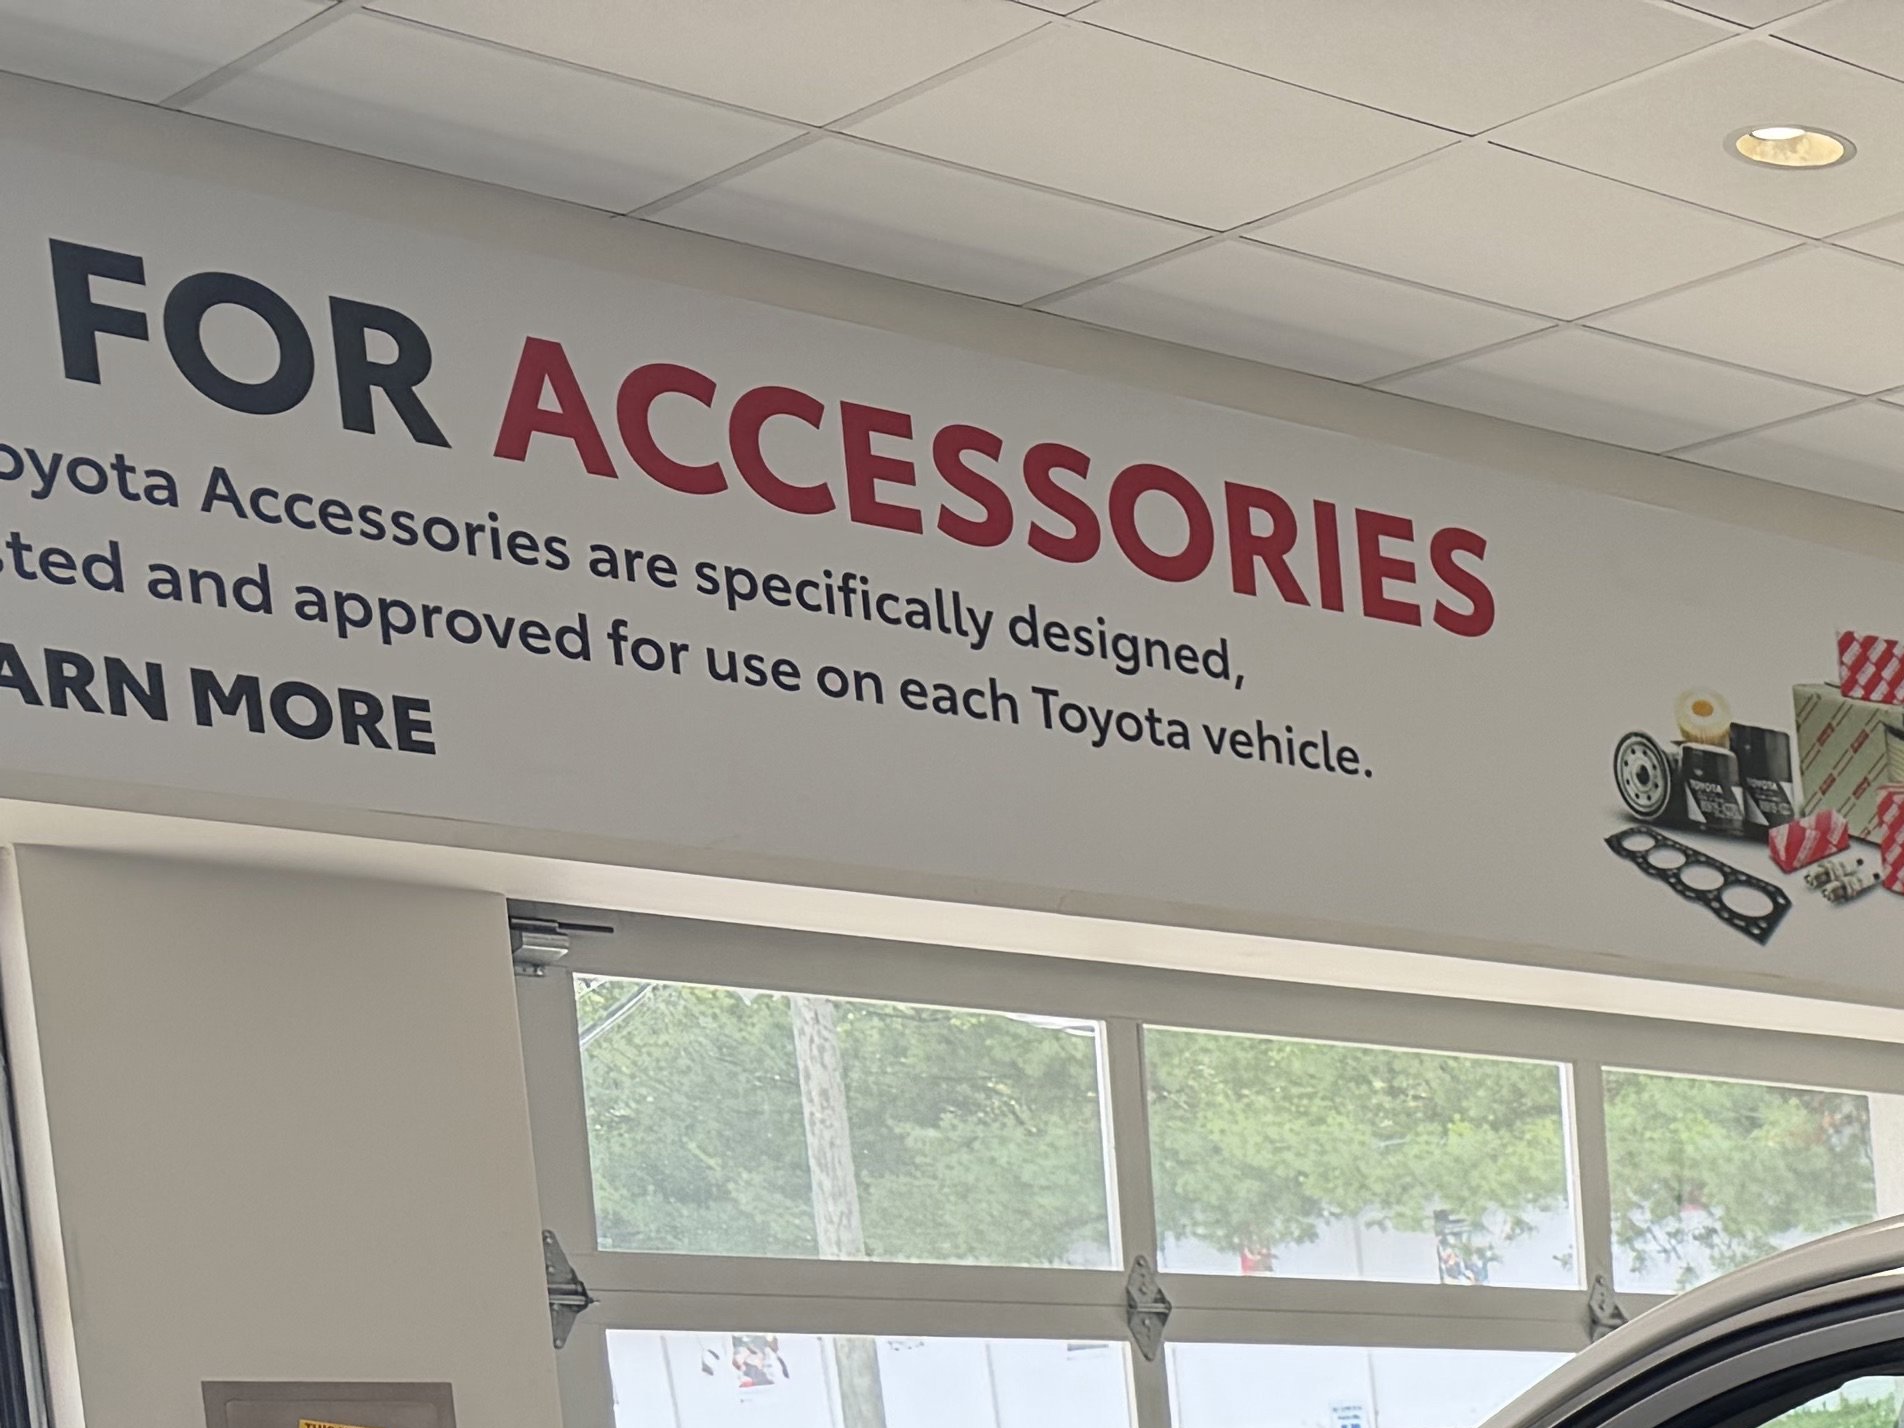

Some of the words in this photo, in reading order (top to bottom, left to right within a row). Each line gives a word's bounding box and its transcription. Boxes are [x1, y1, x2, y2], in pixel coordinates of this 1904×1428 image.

[48, 238, 452, 449] FOR
[493, 336, 1495, 637] ACCESSORIES
[0, 531, 124, 593] ted
[147, 562, 273, 615] and
[294, 580, 591, 662] approved
[608, 620, 689, 674] for
[706, 641, 801, 692] use
[816, 660, 884, 705] on
[900, 677, 1020, 724] each
[1031, 685, 1192, 748] Toyota
[1202, 719, 1374, 778] vehicle.
[200, 466, 570, 572] Accessories
[588, 541, 679, 588] are
[695, 560, 993, 650] specifically
[1007, 603, 1246, 690] designed,
[190, 668, 437, 755] MORE
